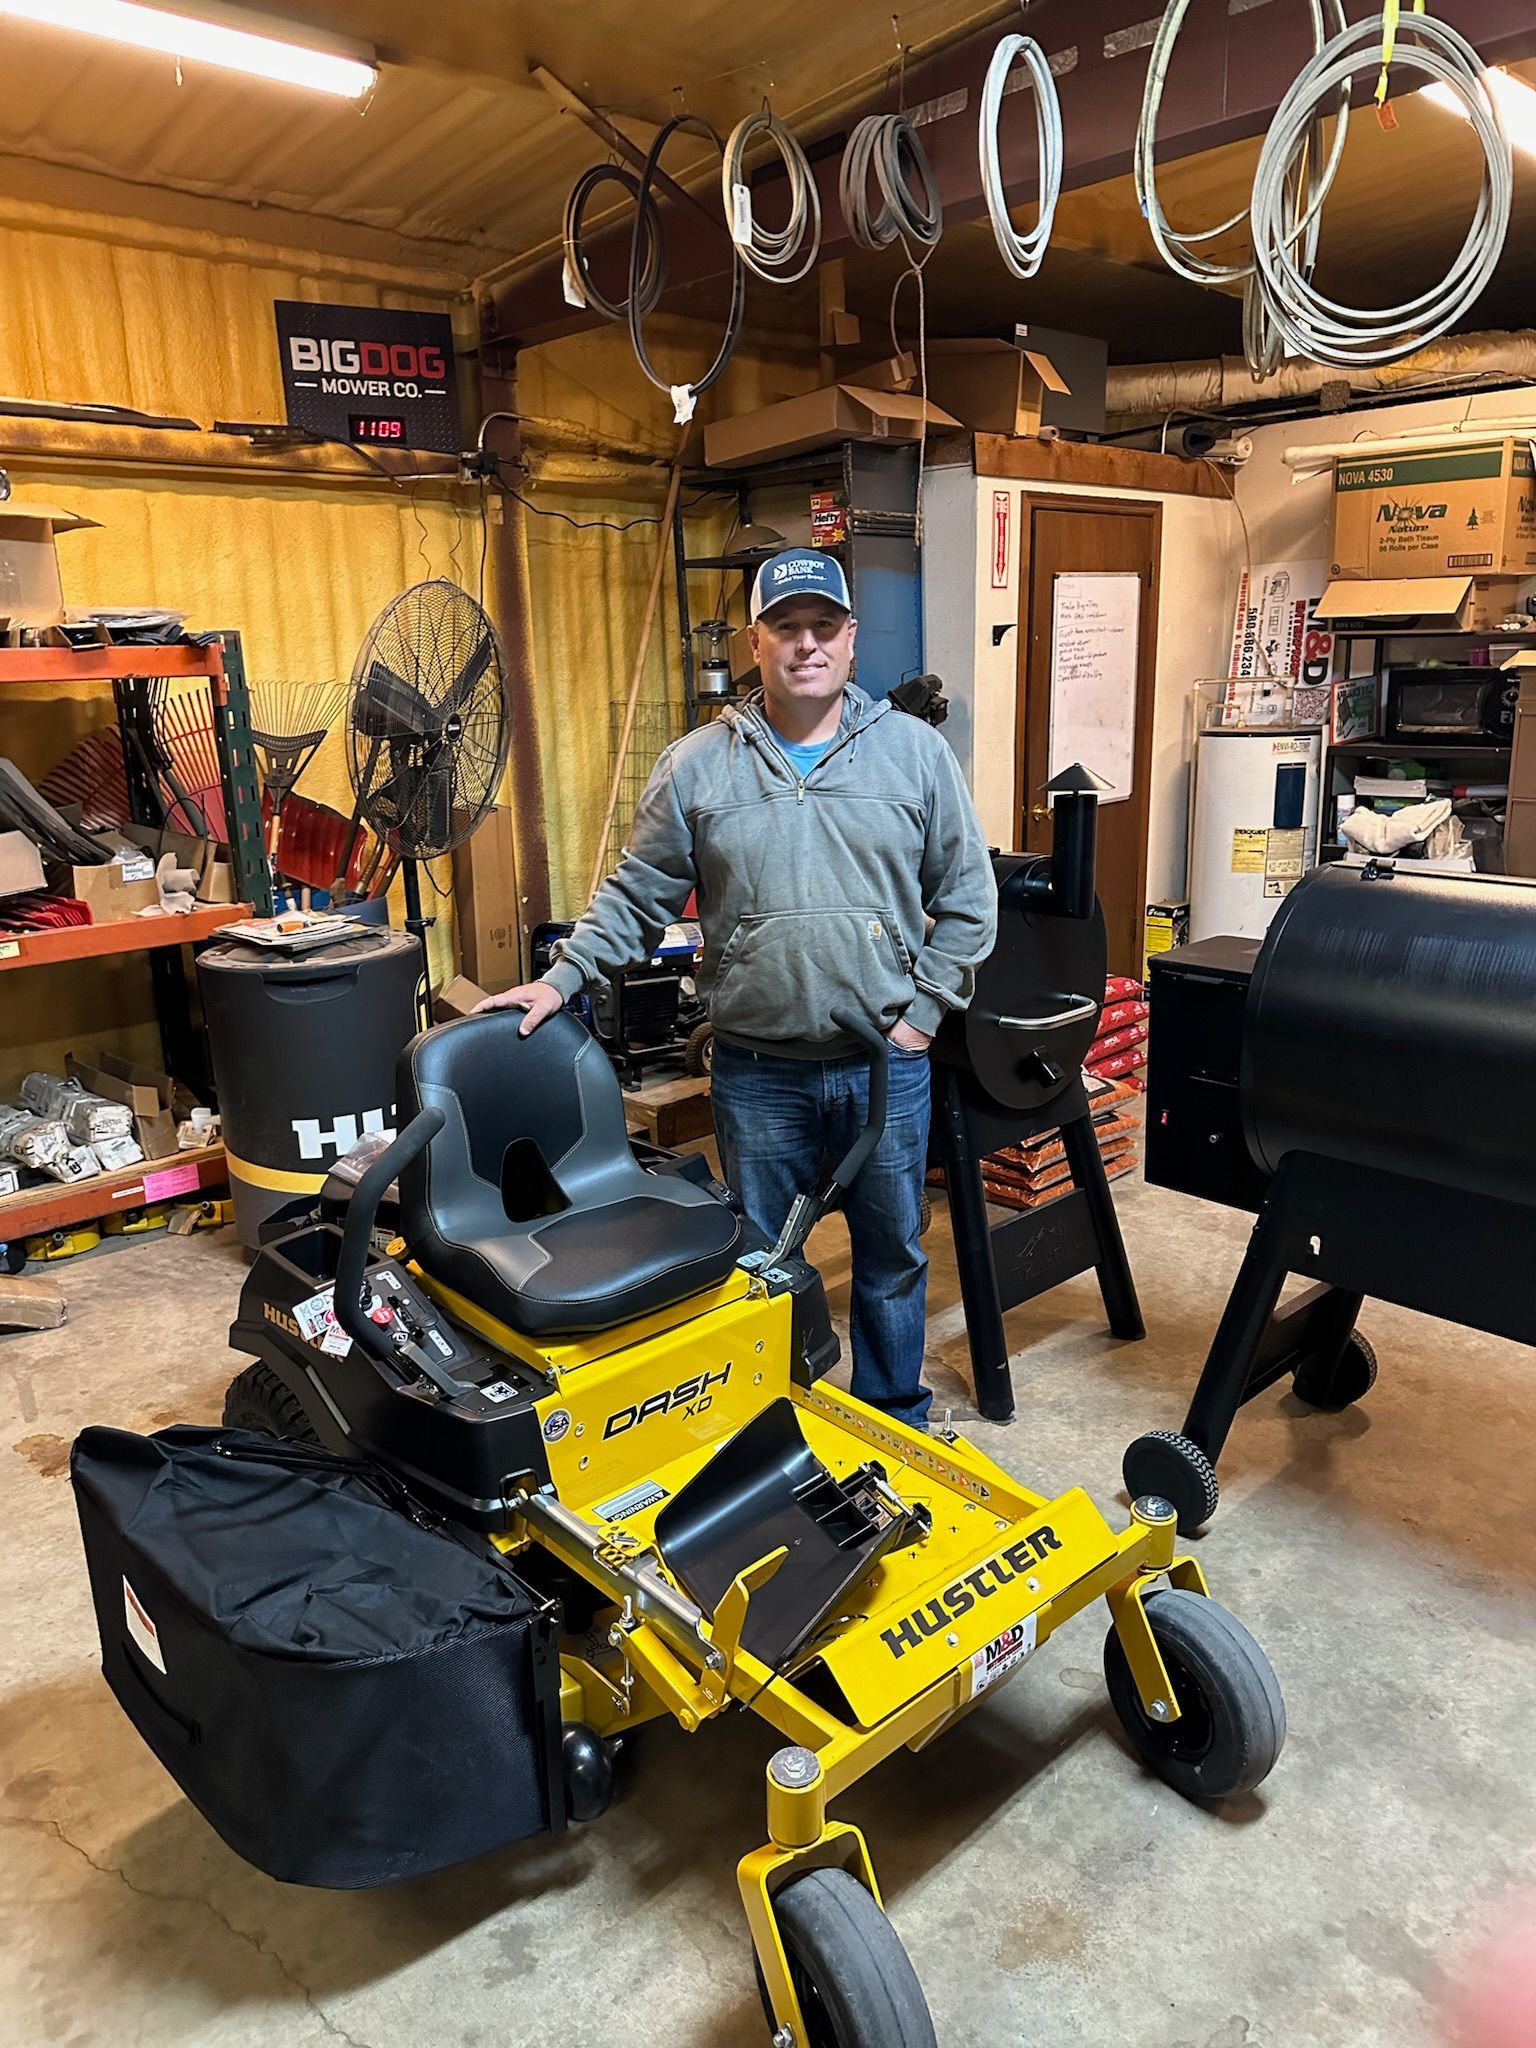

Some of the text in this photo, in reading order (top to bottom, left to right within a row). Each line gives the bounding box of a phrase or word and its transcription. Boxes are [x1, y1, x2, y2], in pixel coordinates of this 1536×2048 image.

[289, 336, 446, 380] BIGDOG
[321, 377, 423, 399] MOWER CO.
[1338, 467, 1394, 486] NOVA 4530
[814, 513, 839, 524] Hefty
[1376, 503, 1448, 523] Nova
[1379, 534, 1440, 546] 2-Ply Bath Tissue
[1389, 544, 1407, 552] Rolls
[1408, 543, 1420, 551] per
[1421, 542, 1440, 550] Case
[787, 559, 825, 570] COWBOY
[601, 1360, 734, 1442] DASH
[681, 1394, 713, 1422] XD
[544, 1416, 570, 1436] USA
[610, 1495, 659, 1523] WARNING!
[879, 1525, 1064, 1660] HUSTLER
[985, 1624, 1024, 1664] M&D
